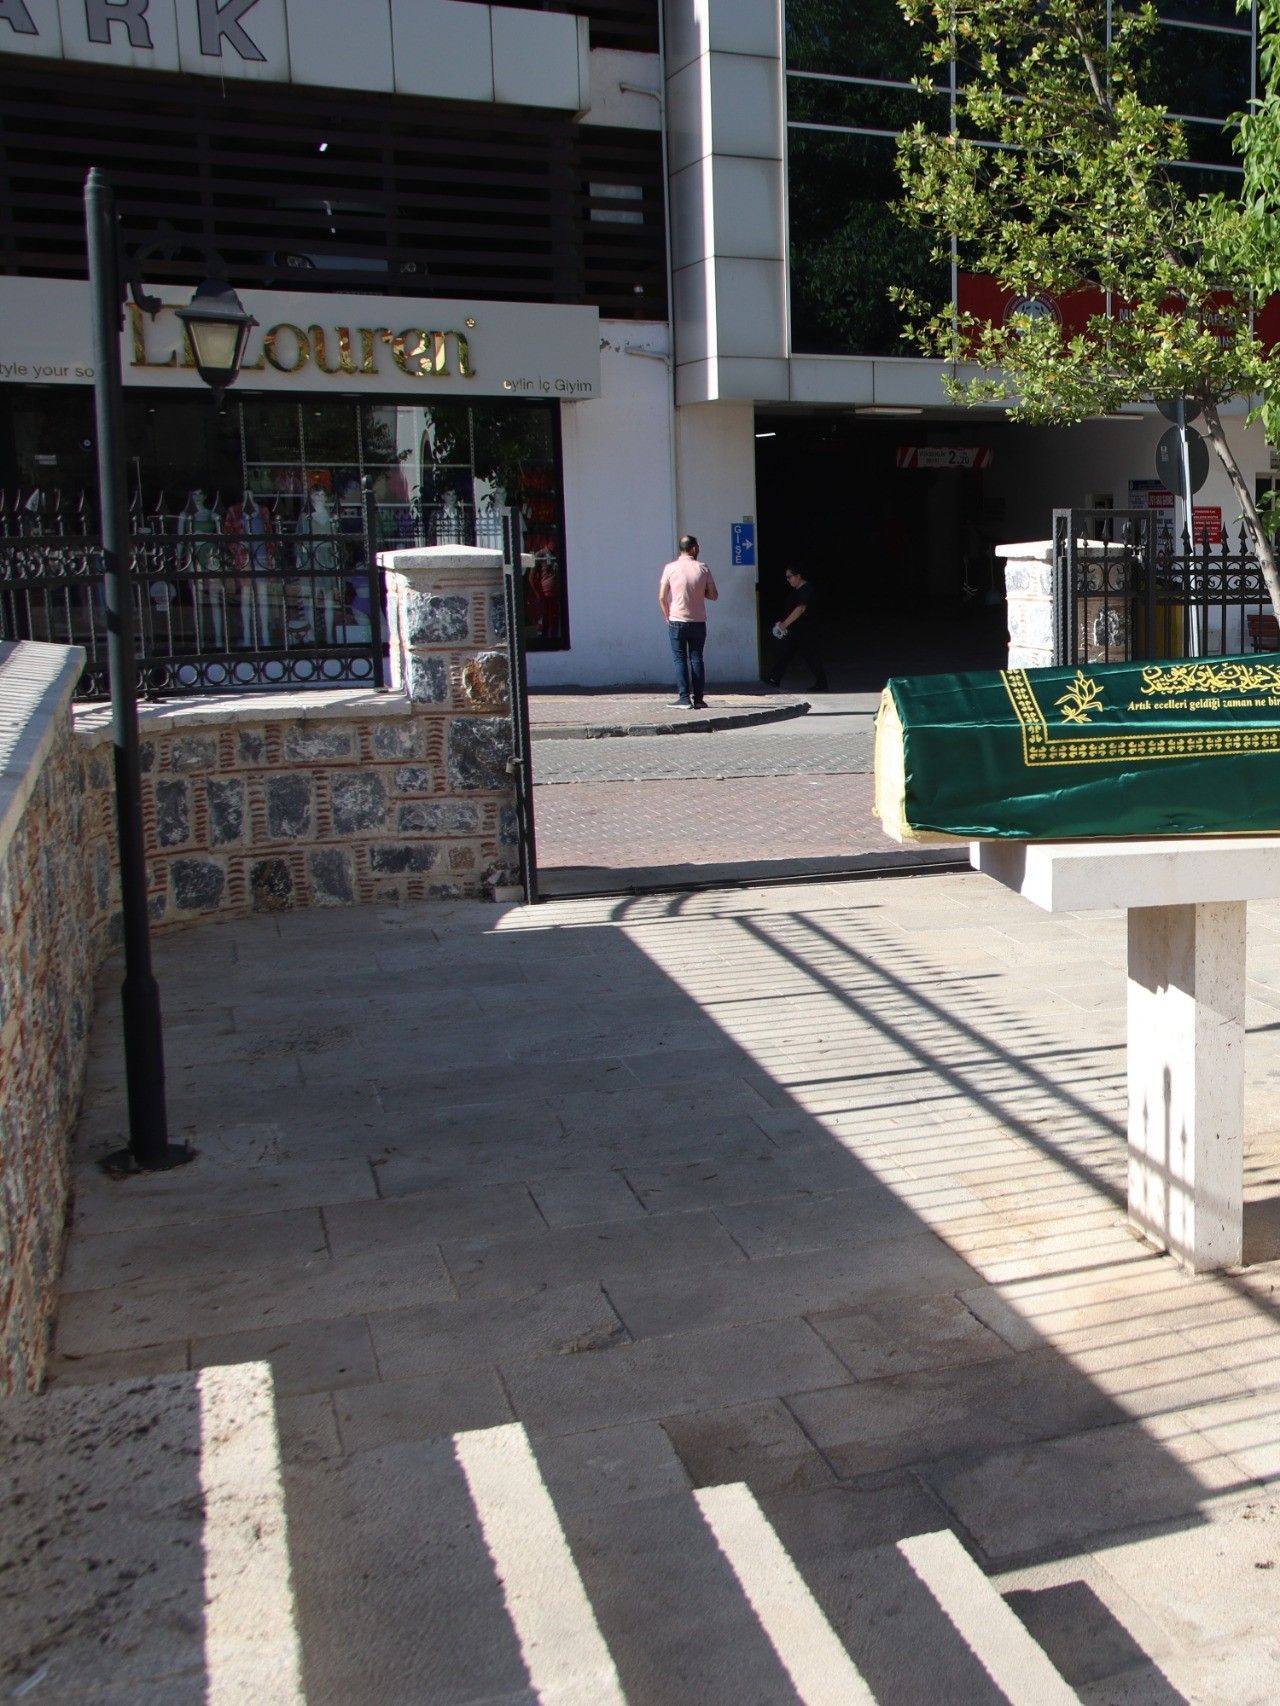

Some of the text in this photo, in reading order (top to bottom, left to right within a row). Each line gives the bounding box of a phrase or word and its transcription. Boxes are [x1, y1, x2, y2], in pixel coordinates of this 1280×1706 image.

[33, 365, 70, 379] your
[554, 379, 592, 394] Giyim
[1127, 700, 1152, 711] Artık
[1154, 699, 1188, 710] ecelleri
[1190, 697, 1221, 711] geldiği
[1224, 699, 1254, 708] zaman
[1268, 696, 1280, 706] bir
